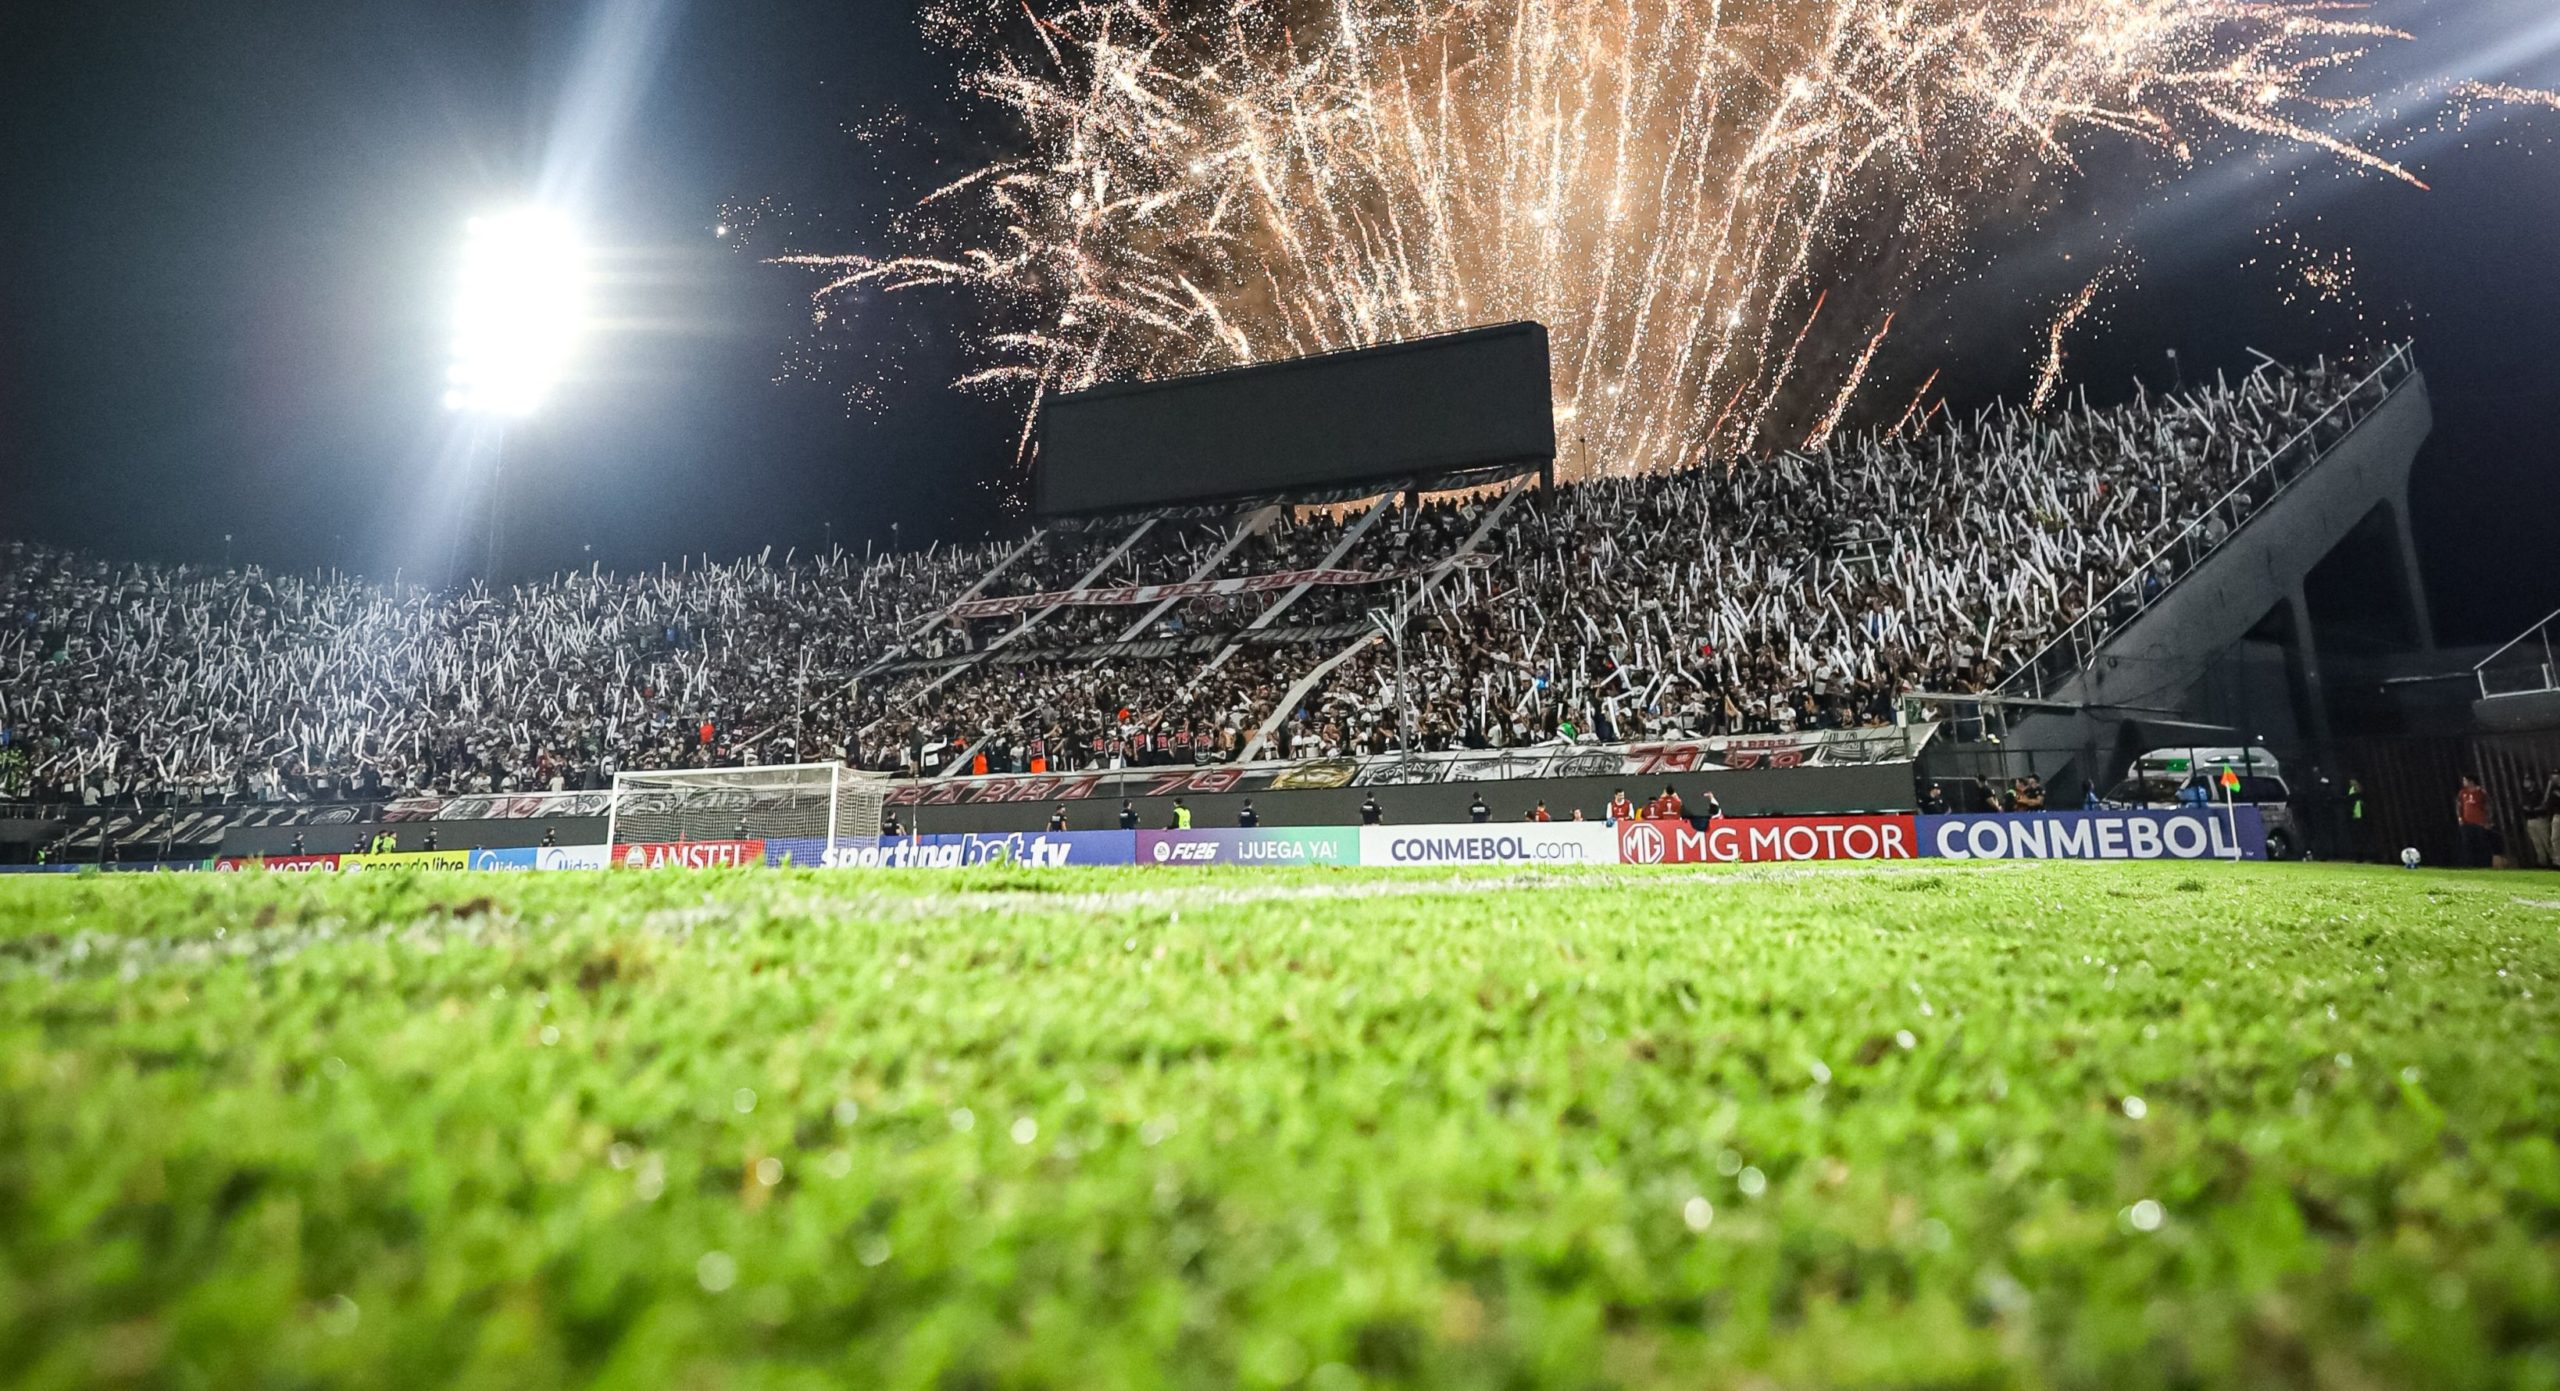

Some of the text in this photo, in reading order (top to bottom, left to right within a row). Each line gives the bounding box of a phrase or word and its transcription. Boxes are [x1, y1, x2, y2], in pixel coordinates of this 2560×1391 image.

[1631, 746, 1699, 774] 79
[1147, 769, 1247, 796] 79
[1238, 841, 1338, 859] ¡JUEGA YA!
[1391, 837, 1583, 861] CONMEBOL.com
[1676, 824, 1910, 862] MG MOTOR
[1937, 815, 2242, 859] CONMEBOL
[1171, 842, 1220, 860] FC26
